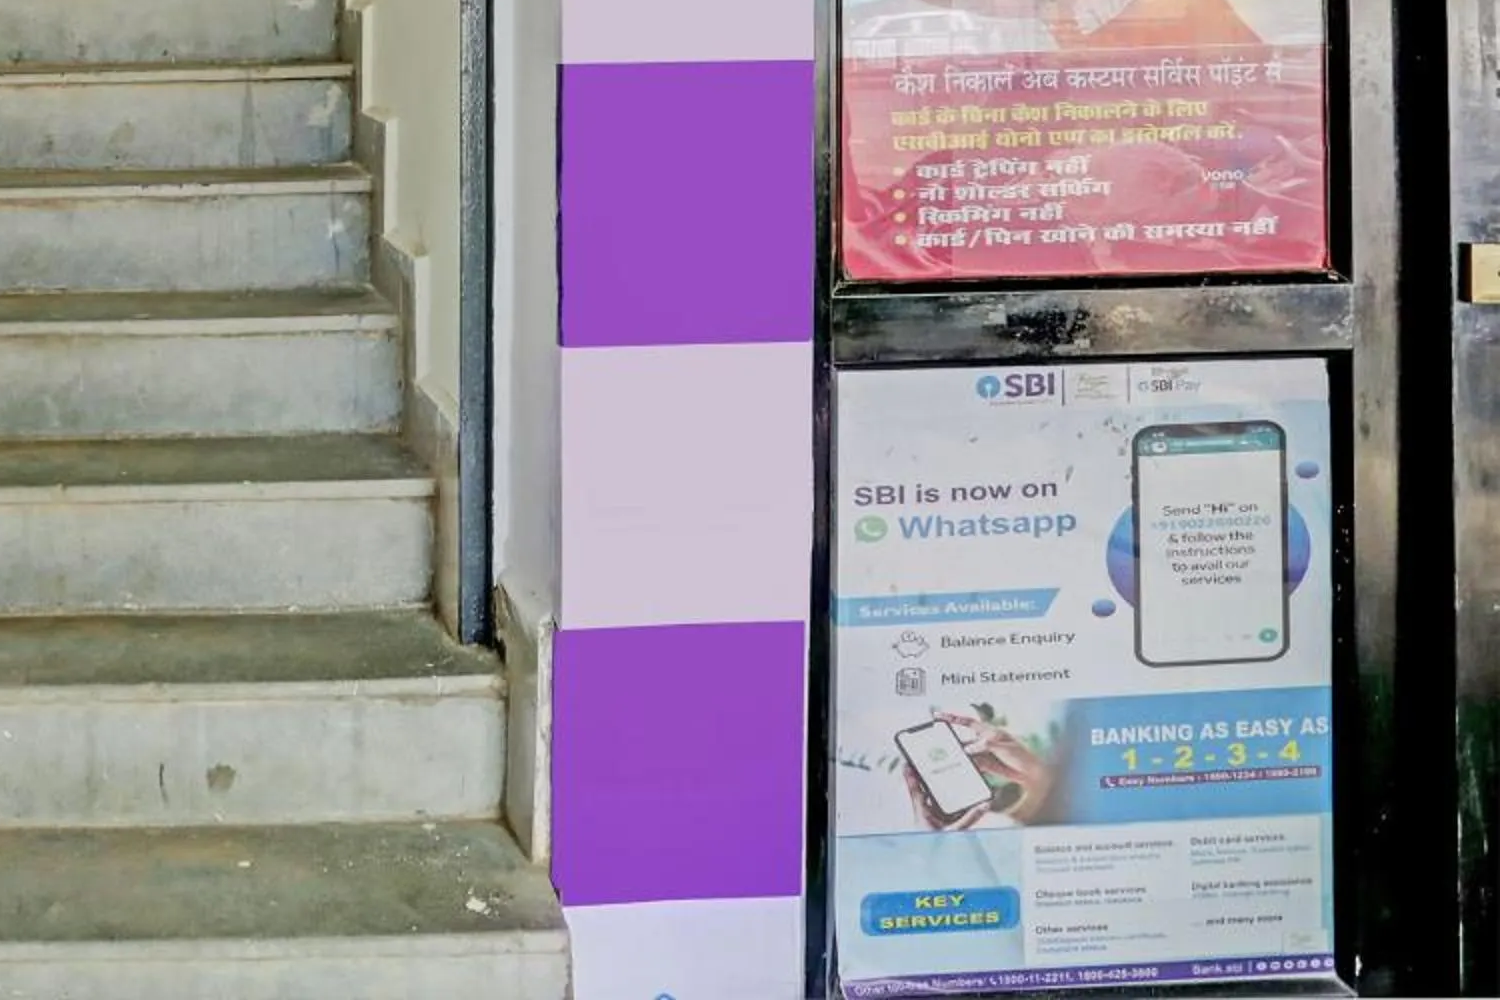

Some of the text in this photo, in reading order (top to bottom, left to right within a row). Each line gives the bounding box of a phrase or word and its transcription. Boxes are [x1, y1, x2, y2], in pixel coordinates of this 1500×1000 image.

[1023, 69, 1060, 90] अब
[1065, 67, 1137, 90] कस्टमर
[1143, 57, 1200, 87] सर्विस
[916, 159, 966, 179] कार्ड
[1045, 154, 1092, 175] नहीं
[1020, 201, 1067, 221] नहीं
[1104, 221, 1136, 241] की
[1233, 215, 1279, 235] नहीं
[1005, 371, 1055, 398] SBI
[1151, 378, 1173, 393] SBI
[853, 482, 1058, 507] SBI is now on
[1162, 504, 1201, 517] Send
[1238, 503, 1259, 514] on
[899, 513, 1078, 539] Whatsapp
[1182, 531, 1226, 544] follow
[1229, 530, 1255, 542] the
[1166, 544, 1257, 559] instructions
[1191, 559, 1223, 572] avail
[1181, 573, 1242, 586] services
[858, 603, 941, 619] Services
[941, 631, 1076, 650] Balance Enquiry
[941, 668, 1072, 686] Mini Statement
[1091, 716, 1329, 746] BANKING AS EASY AS
[1122, 747, 1138, 771] 1
[1174, 744, 1194, 769] 2
[1227, 741, 1247, 766] 3
[1278, 739, 1301, 761] 4
[915, 894, 964, 909] KEY
[880, 912, 999, 929] SERVICES
